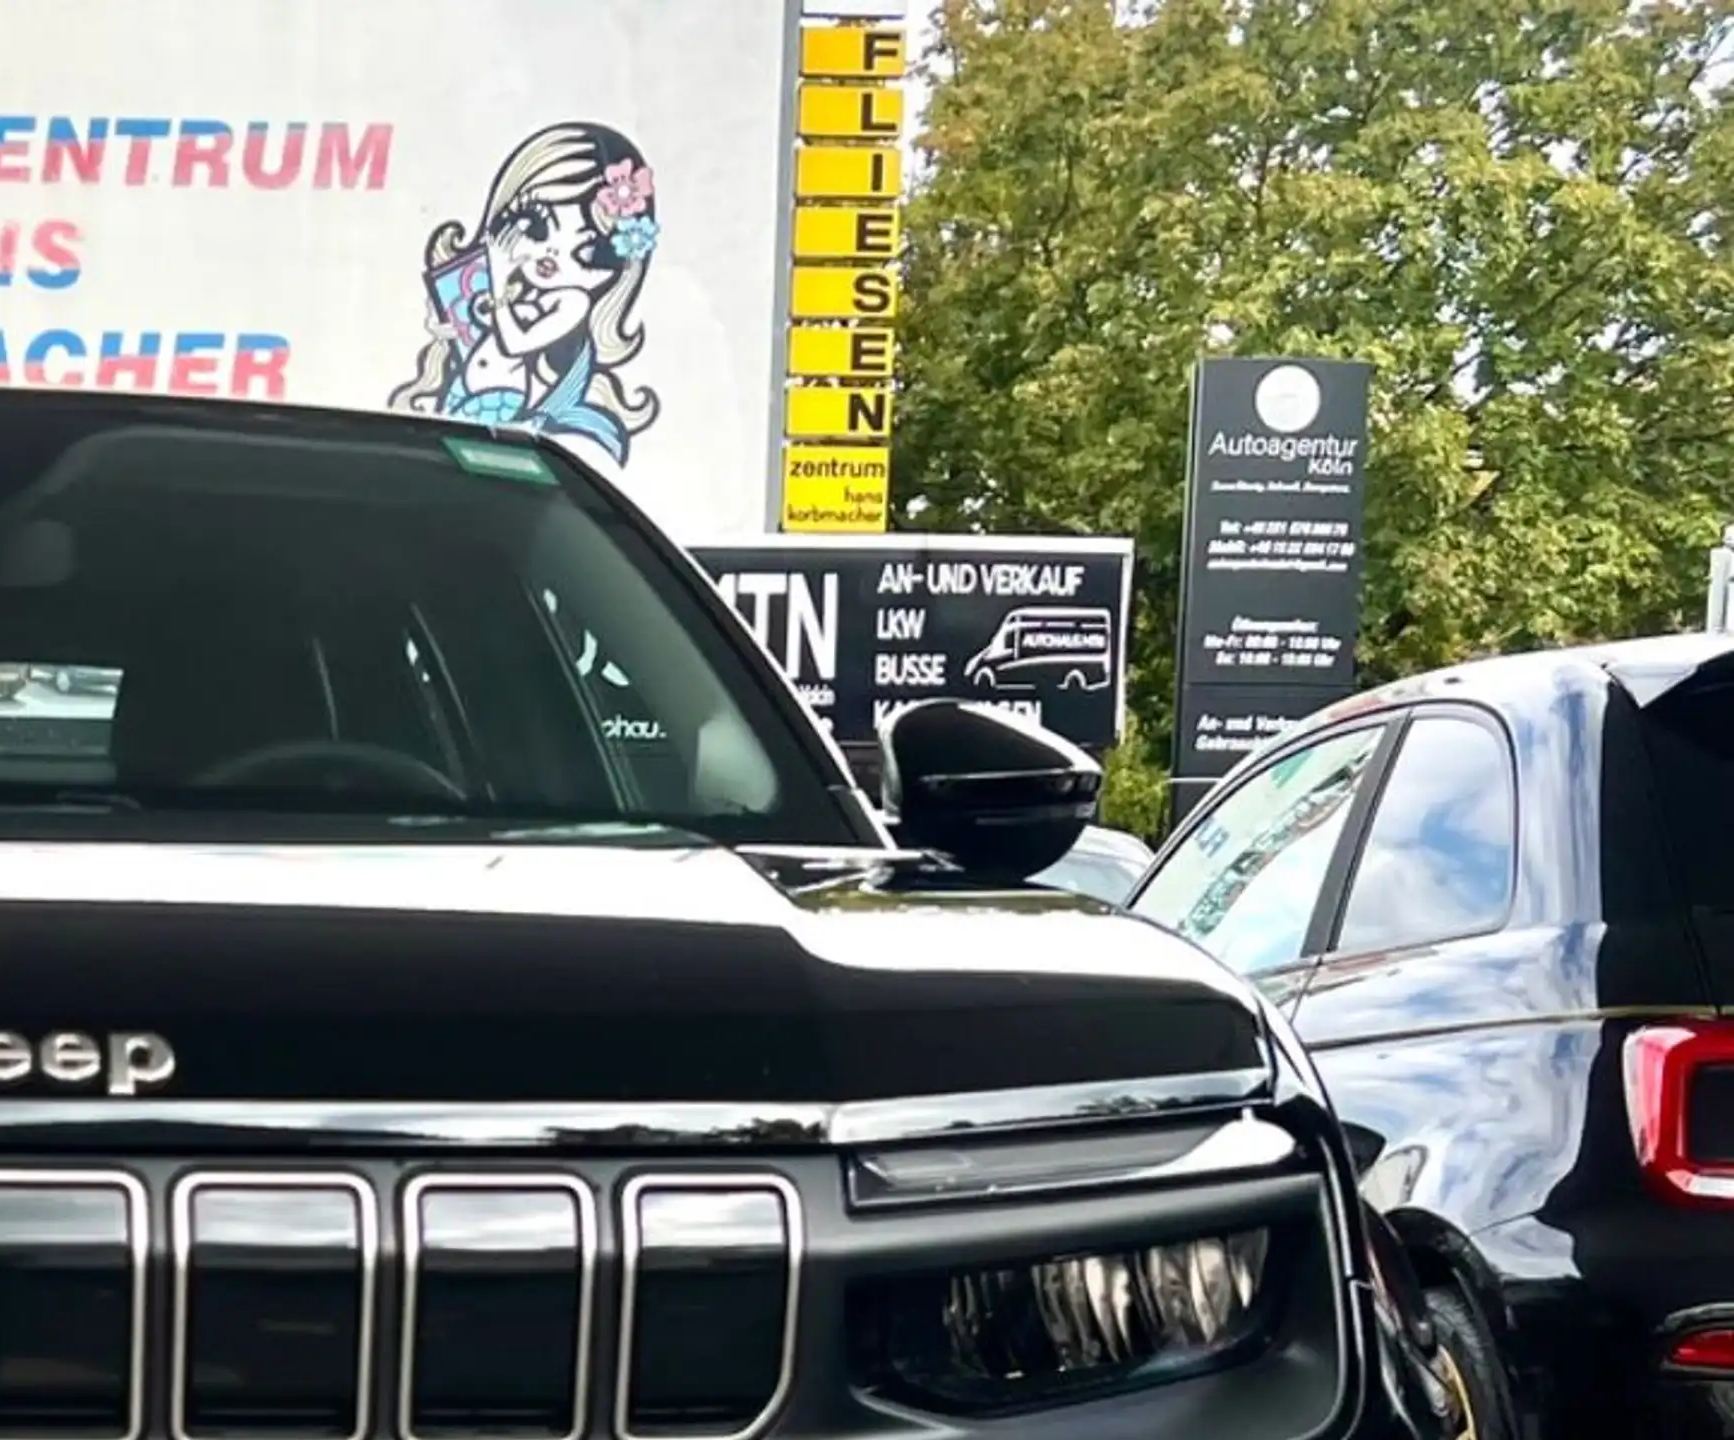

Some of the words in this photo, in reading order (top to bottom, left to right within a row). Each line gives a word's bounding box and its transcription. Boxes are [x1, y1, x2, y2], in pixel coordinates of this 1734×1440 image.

[848, 32, 901, 432] FLIESEN
[1208, 431, 1358, 461] Autoagentur
[790, 457, 886, 478] zentrum
[1308, 458, 1353, 475] Köln
[877, 563, 924, 594] AN-
[927, 563, 977, 594] UND
[980, 564, 1085, 596] VERKAUF
[876, 608, 926, 640] LKW
[875, 653, 947, 686] BUSSE
